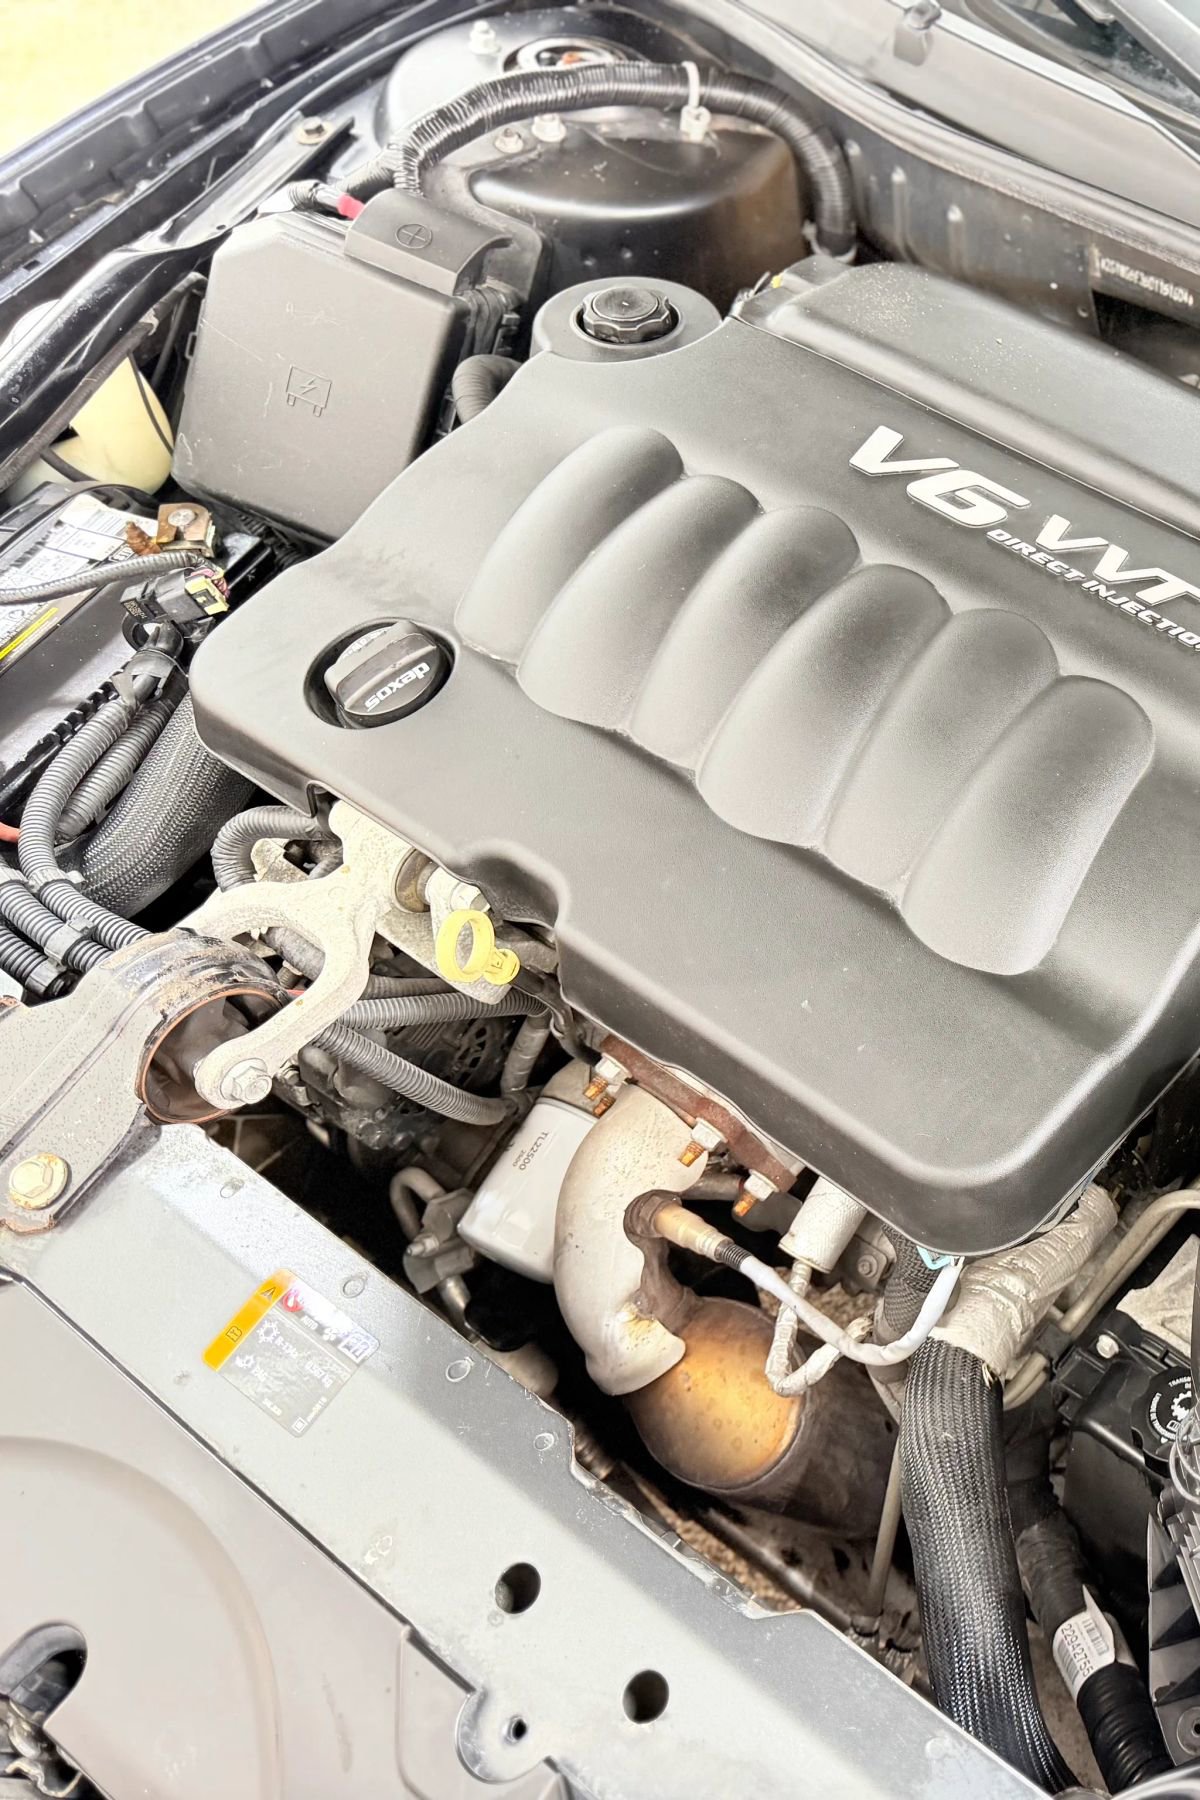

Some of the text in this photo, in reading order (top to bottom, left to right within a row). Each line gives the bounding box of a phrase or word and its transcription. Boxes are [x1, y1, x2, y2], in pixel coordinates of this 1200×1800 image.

[849, 425, 1032, 528] V6
[986, 528, 1087, 581] DIRECT
[364, 662, 430, 712] dexos
[1061, 1623, 1094, 1678] 22942755
